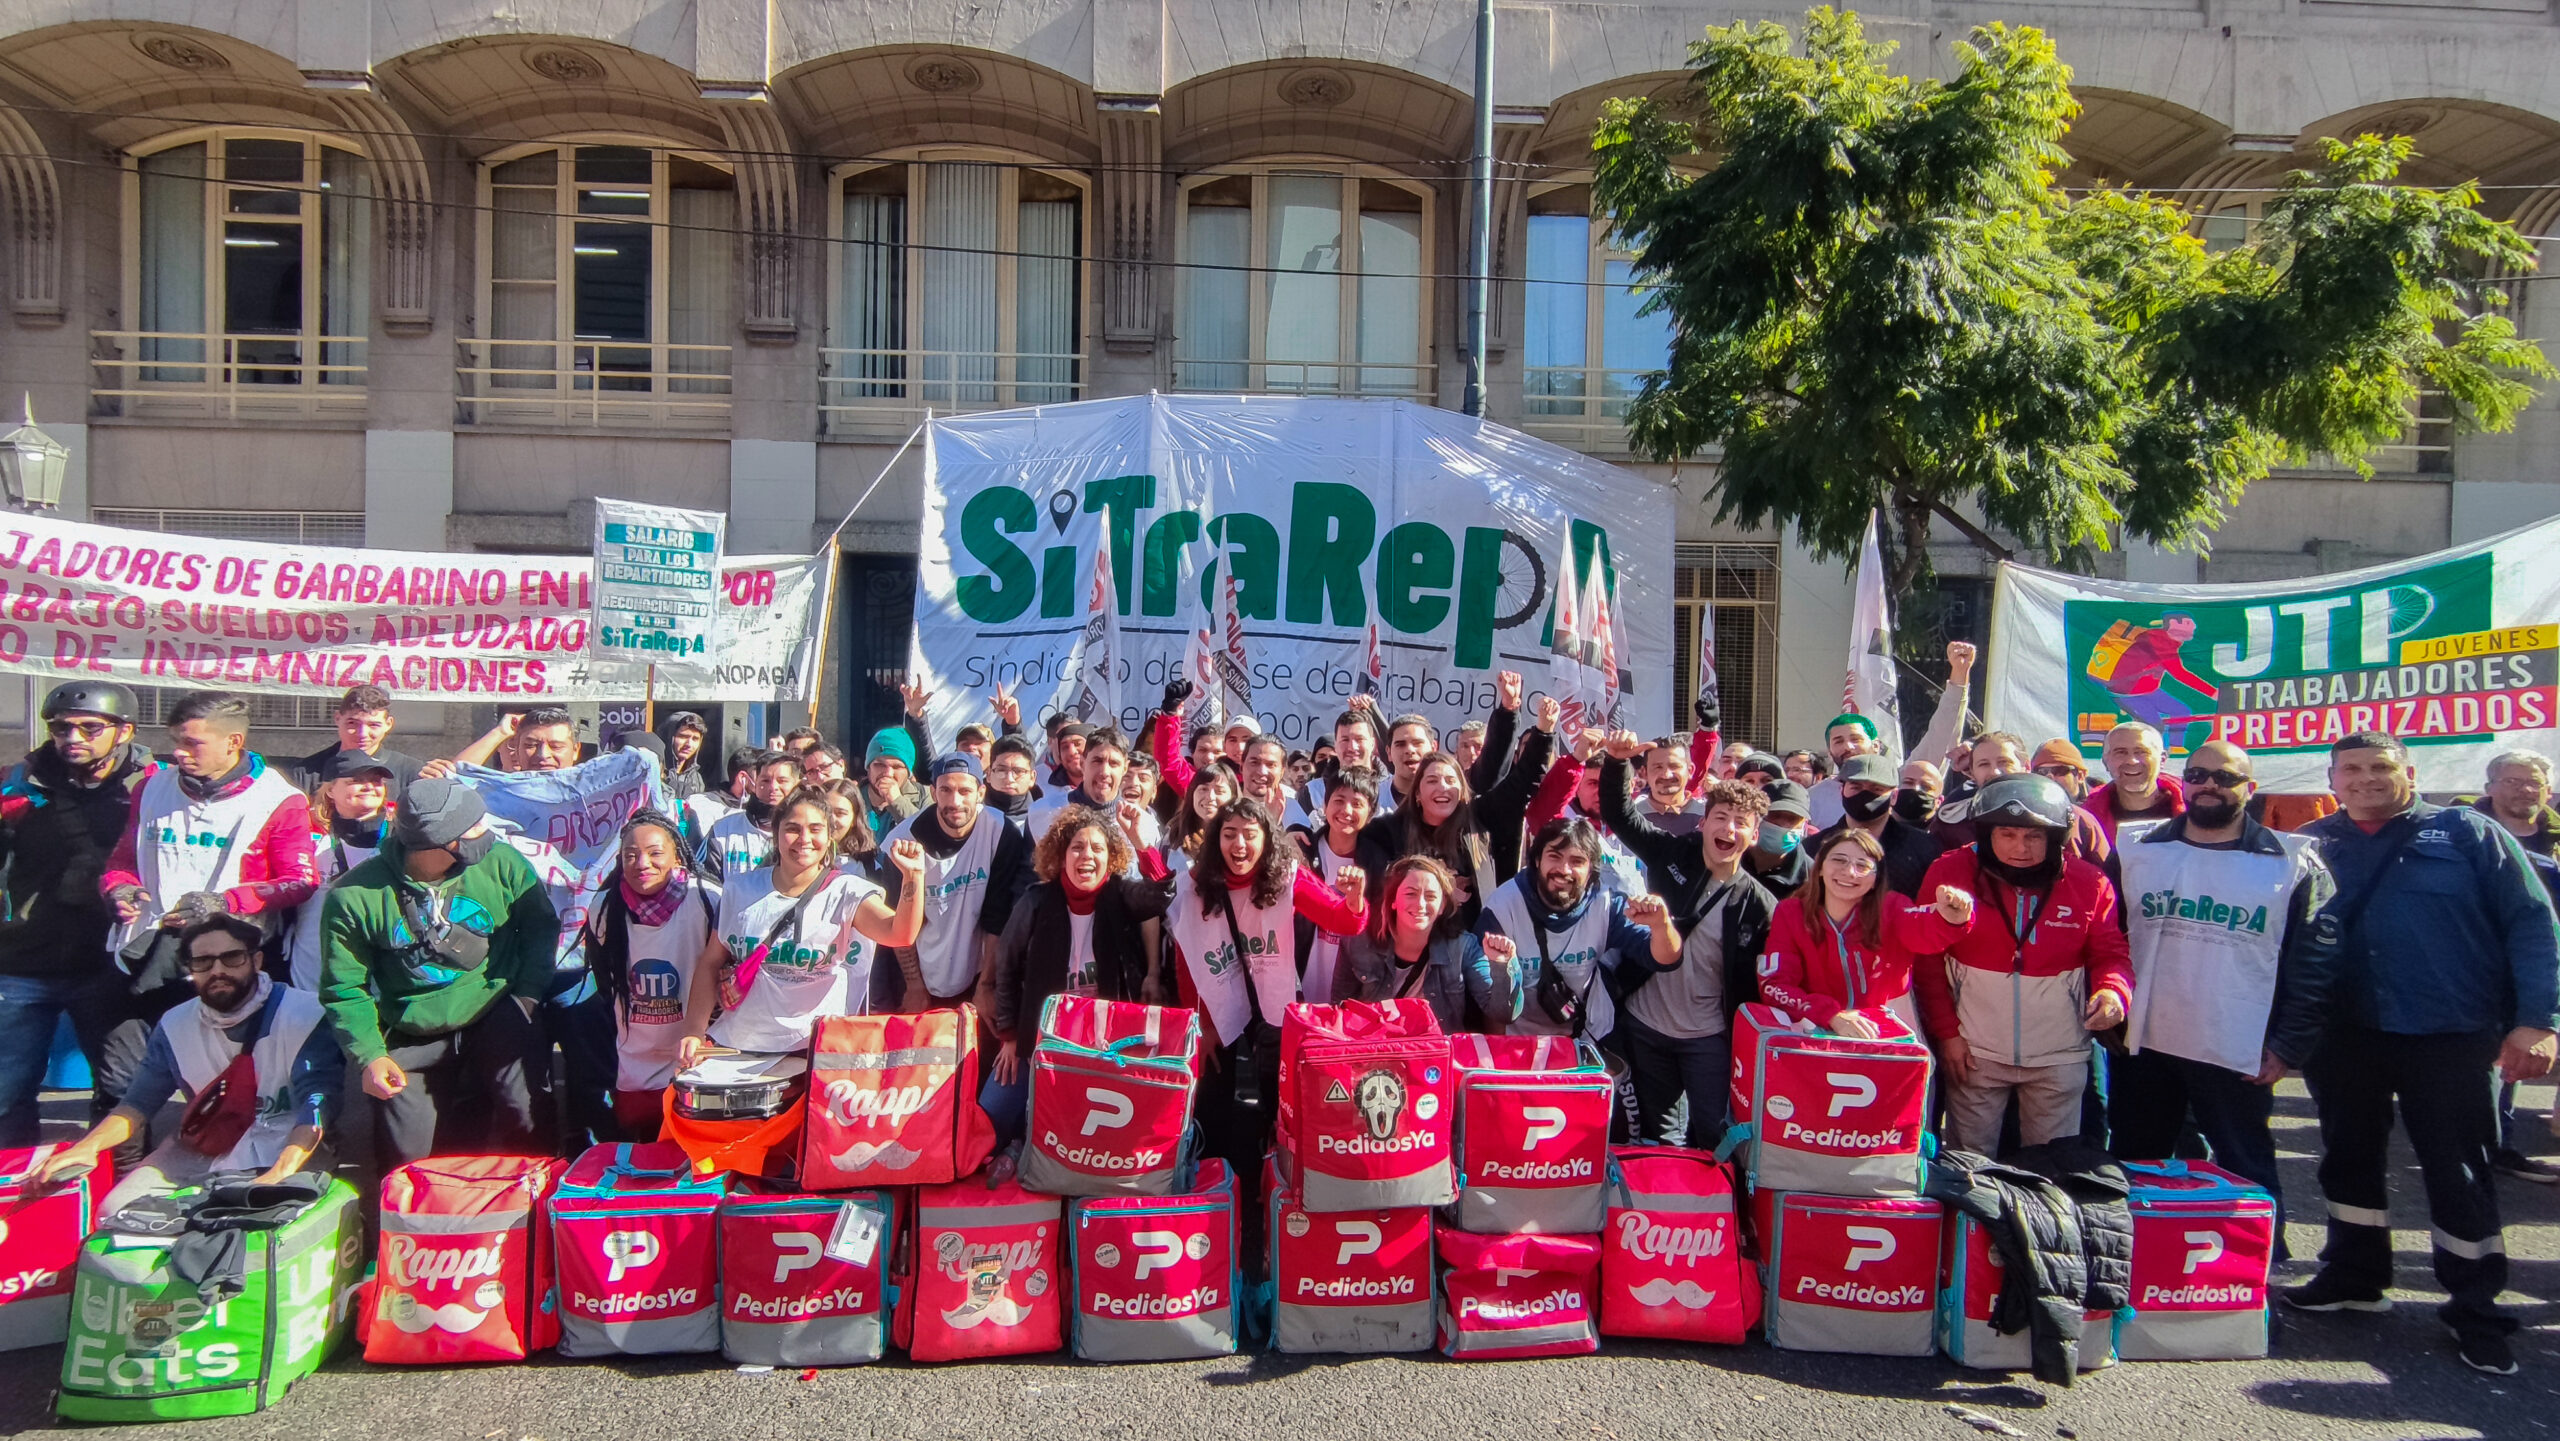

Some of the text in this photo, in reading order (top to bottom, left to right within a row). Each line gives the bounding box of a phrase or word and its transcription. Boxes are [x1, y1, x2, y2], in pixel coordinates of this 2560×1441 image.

[625, 525, 695, 549] SALARIO
[627, 549, 690, 567] PARA LOS
[956, 474, 1616, 671] SiTraRepA
[213, 556, 268, 597] DE
[274, 559, 507, 608] GARBARINO
[520, 570, 568, 608] EN
[604, 563, 710, 588] REPARTIDORES
[160, 599, 350, 644] SUELDOS
[602, 595, 709, 617] RECONOCIMIENTO
[639, 615, 672, 628] YA DEL
[601, 625, 705, 657] SiTraRepA
[2212, 583, 2434, 679] JTP
[2420, 628, 2541, 660] JOVENES
[53, 630, 117, 672] DE
[963, 651, 1131, 689] Sindicao
[1145, 652, 1183, 687] de
[1306, 660, 1353, 697] de
[2233, 655, 2534, 710] TRABAJADORES
[2218, 690, 2547, 748] PRECARIZADOS
[2141, 889, 2267, 931] SiTraRepA
[727, 934, 837, 972] SiTaRepA
[635, 973, 677, 997] JTP
[824, 1074, 939, 1129] Rappi
[1043, 1130, 1162, 1171] PedidosYa
[1318, 1129, 1435, 1155] PedidosYa
[1783, 1121, 1903, 1149] PedidosYa
[1482, 1157, 1592, 1180] PedidosYa
[934, 1226, 1047, 1282] Rappi
[1617, 1210, 1726, 1267] Rappi
[388, 1233, 509, 1292] Rappi
[574, 1287, 697, 1315] PedidosYa
[733, 1287, 864, 1319] PedidosYa
[1093, 1286, 1219, 1315] PedidosYa
[1298, 1275, 1415, 1299] PedidosYa
[1797, 1276, 1926, 1306] PedidosYa
[2143, 1283, 2253, 1304] PedidosYa
[1461, 1289, 1582, 1319] PedidosYa
[69, 1334, 241, 1387] Eats
